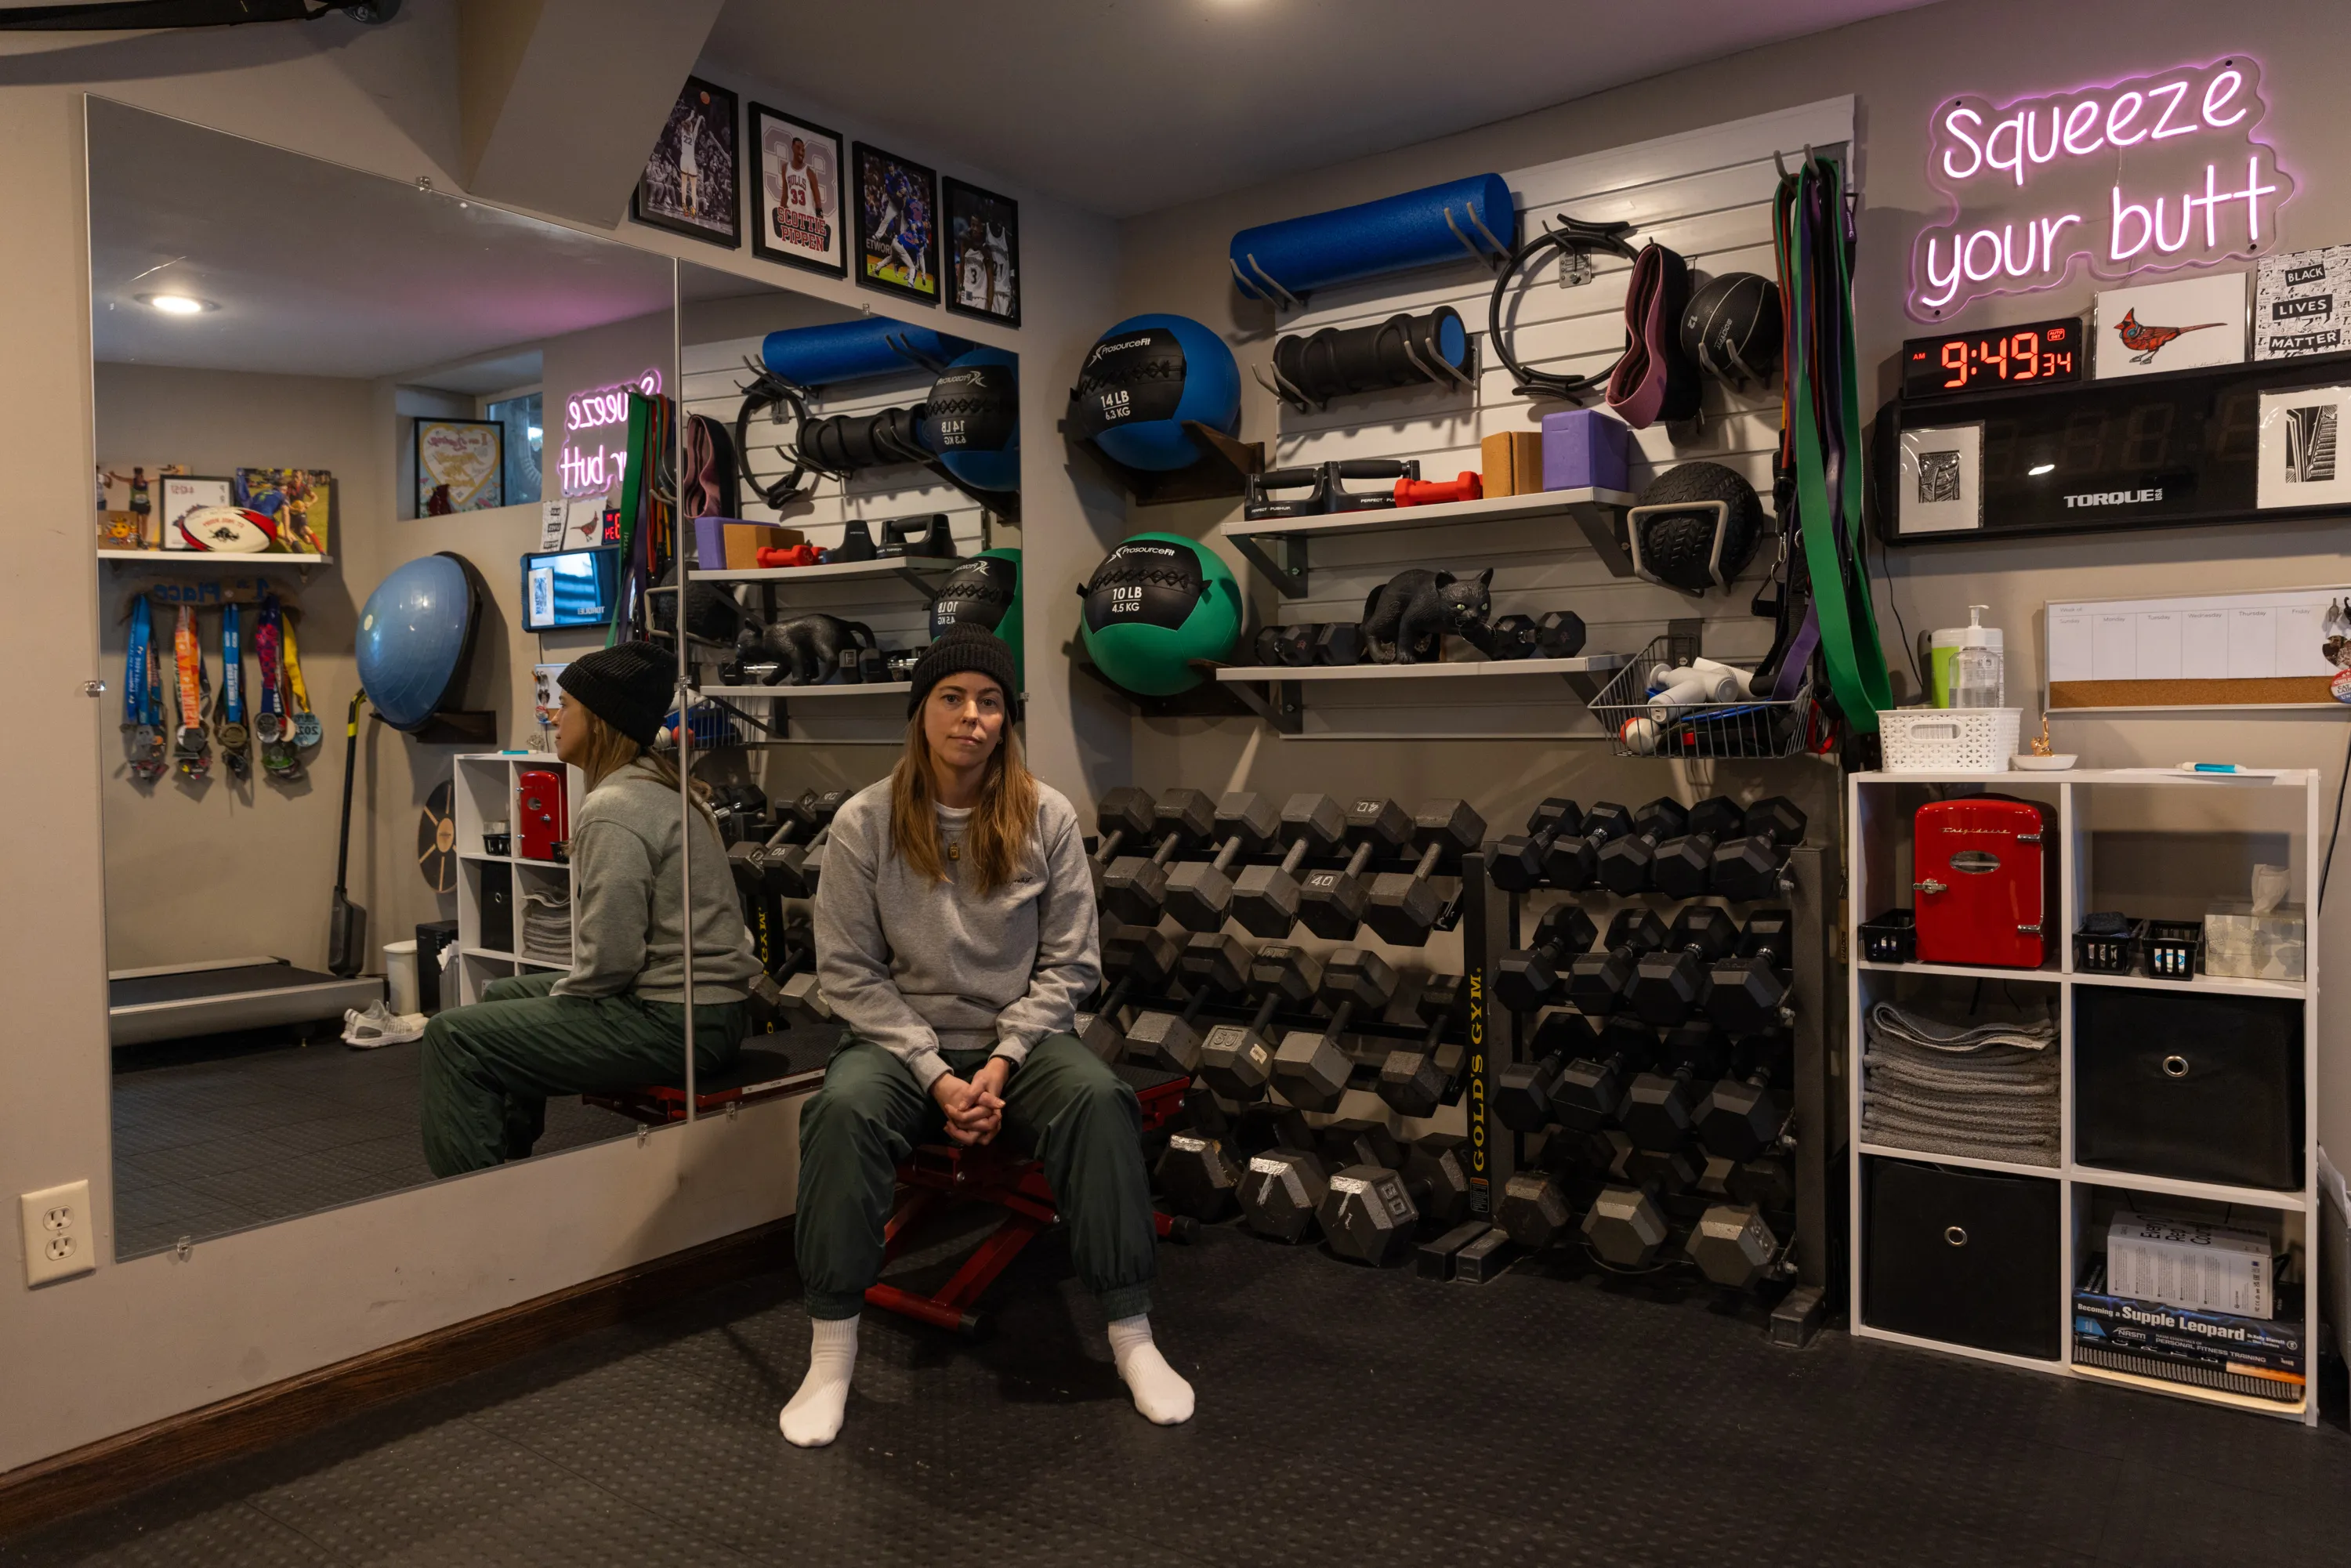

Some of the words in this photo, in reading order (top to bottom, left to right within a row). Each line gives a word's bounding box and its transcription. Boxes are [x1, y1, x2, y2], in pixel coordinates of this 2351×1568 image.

[1943, 70, 2247, 186] Squeeze
[683, 135, 693, 146] 22
[791, 188, 806, 206] 33
[777, 206, 826, 235] SCOTTIE
[781, 226, 824, 252] PIPPEN
[1922, 213, 2081, 307] your
[2110, 157, 2276, 261] butt
[971, 268, 977, 284] 3
[2288, 266, 2324, 283] BLACK
[2279, 299, 2327, 315] LIVES
[1687, 316, 1697, 329] 12
[1101, 338, 1151, 355] ProsourceFit
[2271, 331, 2337, 348] MATTER
[1942, 332, 2038, 388] 9:49
[2042, 352, 2071, 376] 34
[1100, 393, 1114, 408] 14
[1115, 390, 1130, 404] LB
[1105, 410, 1117, 421] 6.3
[1117, 407, 1131, 418] KG
[2063, 489, 2154, 509] TORQUE
[1122, 547, 1176, 556] ProsourceFit
[1113, 587, 1126, 600] 10
[1128, 586, 1142, 599] LB
[1111, 603, 1124, 613] 4.5
[1125, 602, 1140, 611] KG
[1357, 802, 1379, 813] 40
[1311, 875, 1334, 886] 40
[1470, 1054, 1484, 1171] GOLD'S
[2140, 1222, 2168, 1239] Every
[2165, 1228, 2191, 1242] Rep
[2078, 1303, 2114, 1317] Becoming
[2122, 1306, 2175, 1327] Supple
[2179, 1316, 2245, 1342] Leopard
[2118, 1329, 2146, 1339] NASM
[2156, 1338, 2195, 1350] PERSONAL
[2197, 1345, 2229, 1356] FITNESS
[2230, 1351, 2266, 1363] TRAINING
